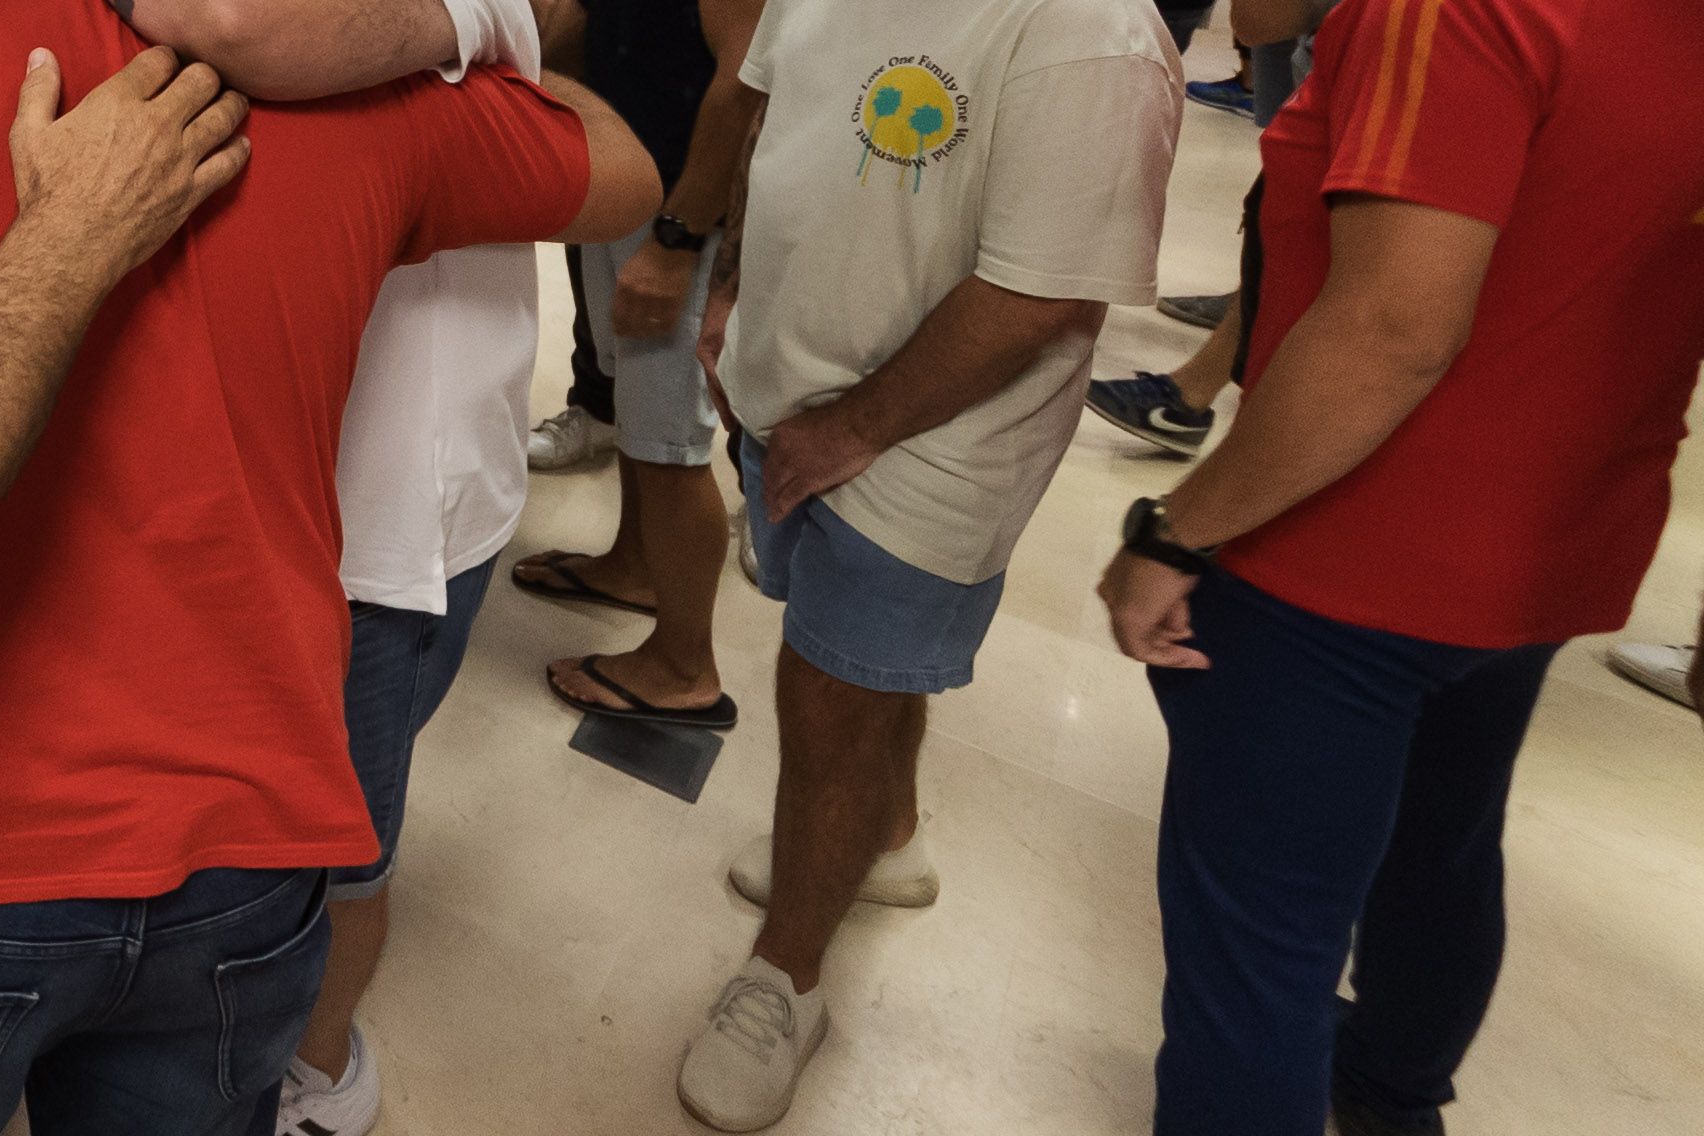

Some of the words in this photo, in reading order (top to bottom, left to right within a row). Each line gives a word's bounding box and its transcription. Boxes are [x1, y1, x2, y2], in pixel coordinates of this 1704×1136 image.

[888, 56, 915, 67] One
[917, 54, 958, 92] Family
[861, 65, 885, 90] Love
[851, 94, 864, 123] One
[956, 94, 969, 123] One
[855, 128, 928, 170] Movement
[930, 128, 969, 162] World
